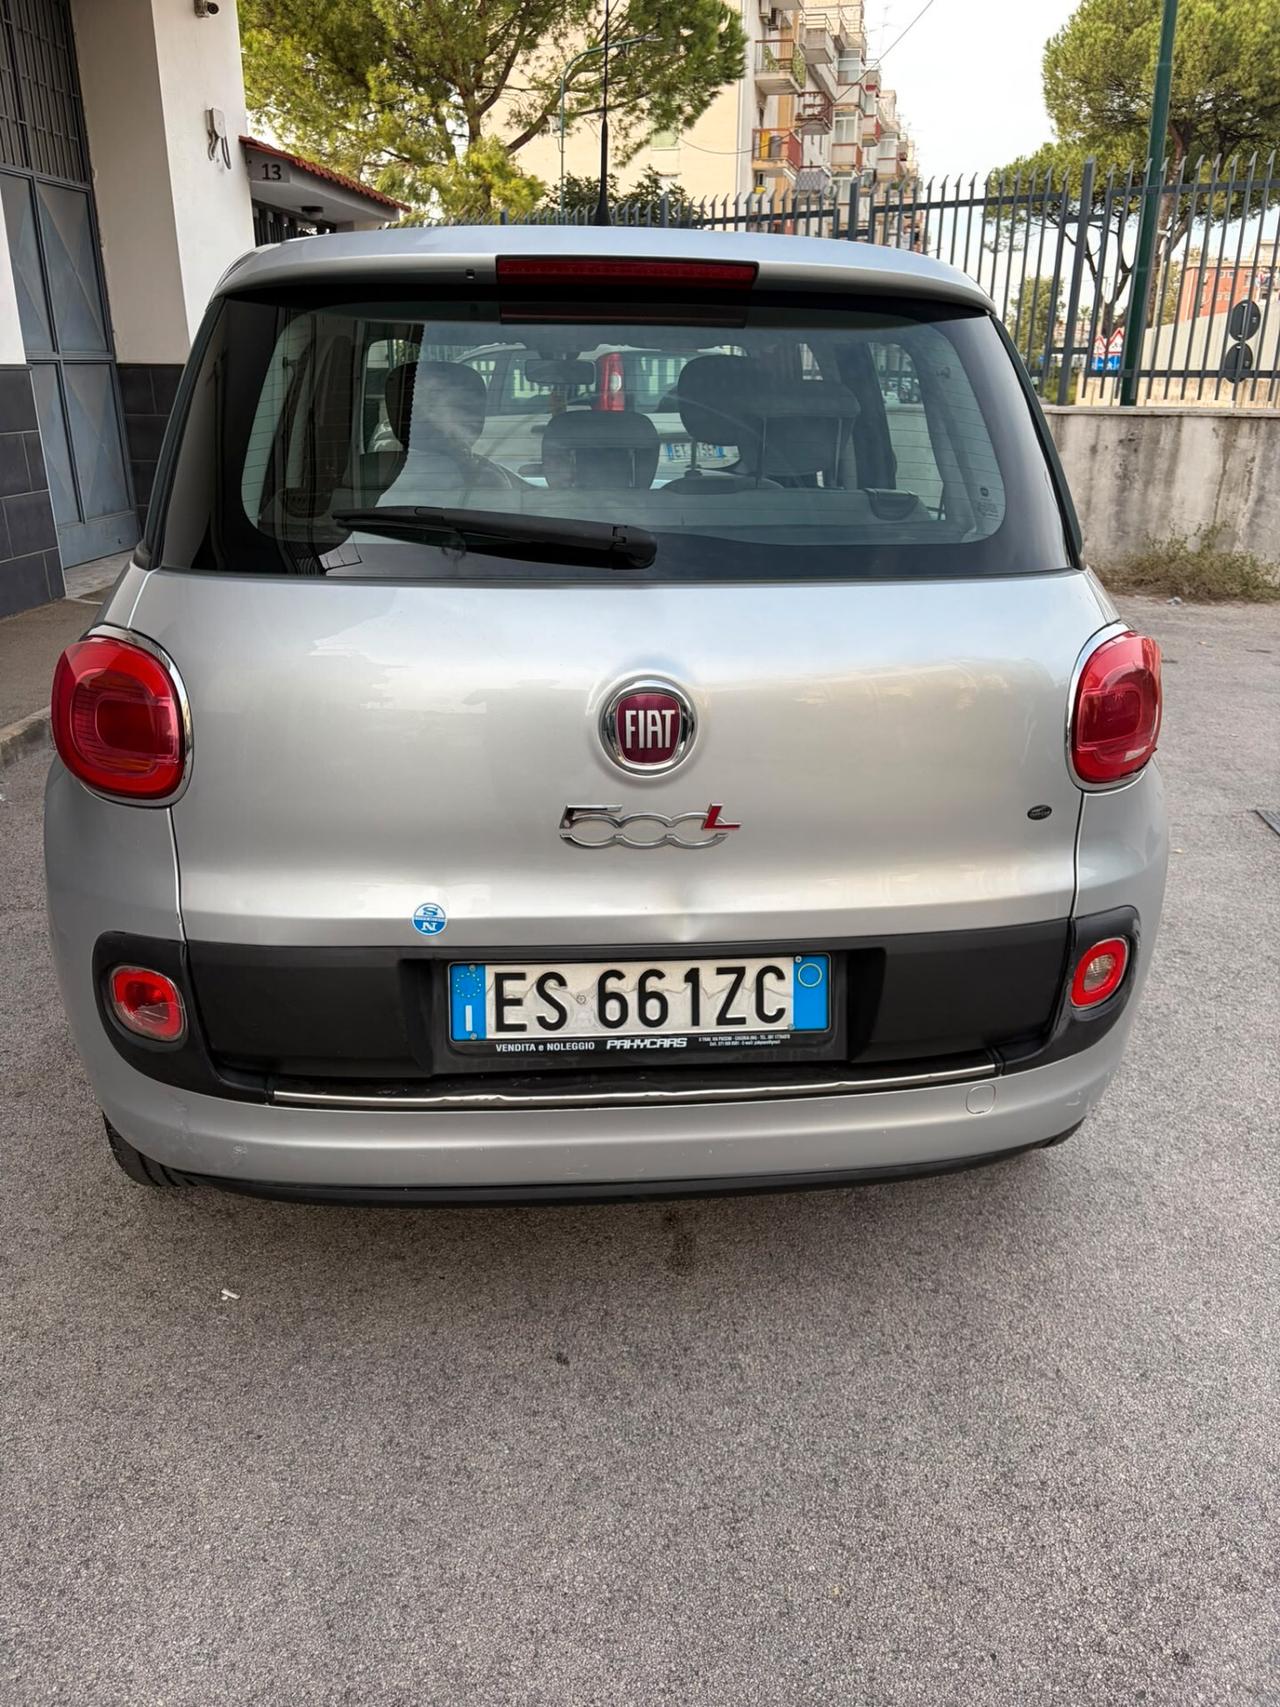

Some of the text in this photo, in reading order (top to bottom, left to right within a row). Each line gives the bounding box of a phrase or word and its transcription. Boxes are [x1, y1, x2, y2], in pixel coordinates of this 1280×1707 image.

[262, 163, 282, 180] 13
[625, 709, 676, 749] FIAT
[558, 802, 743, 850] 500L
[420, 921, 438, 931] N
[494, 971, 568, 1032] ES
[495, 1041, 595, 1052] VENDITA e NOLEGGIO
[605, 1036, 688, 1050] PAHYCARS
